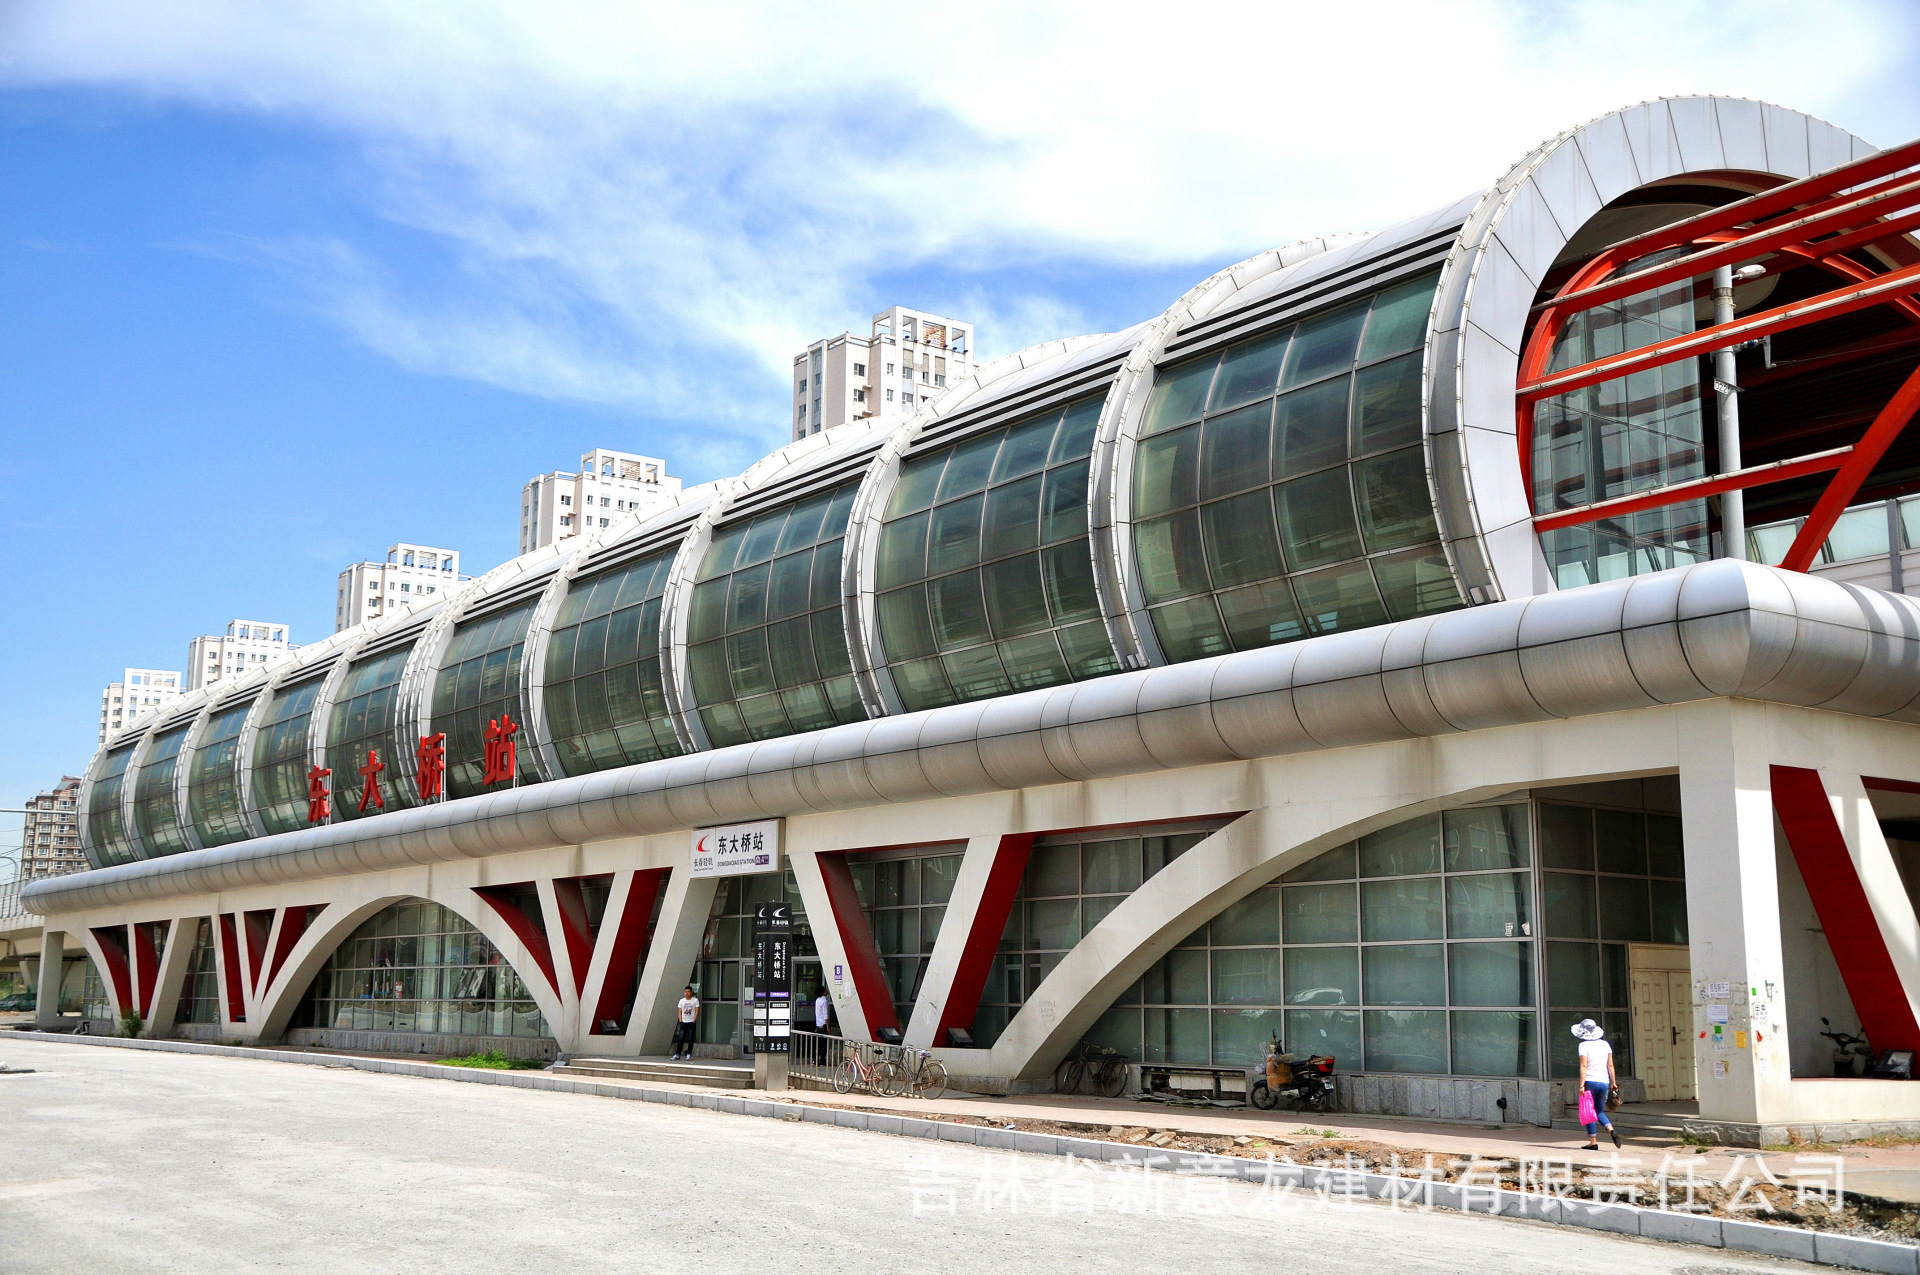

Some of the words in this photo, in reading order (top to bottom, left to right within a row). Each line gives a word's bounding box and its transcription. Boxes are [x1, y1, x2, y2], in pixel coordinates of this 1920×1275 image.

[308, 714, 517, 823] 东大桥站
[718, 832, 763, 855] 东大桥站
[836, 966, 841, 975] B
